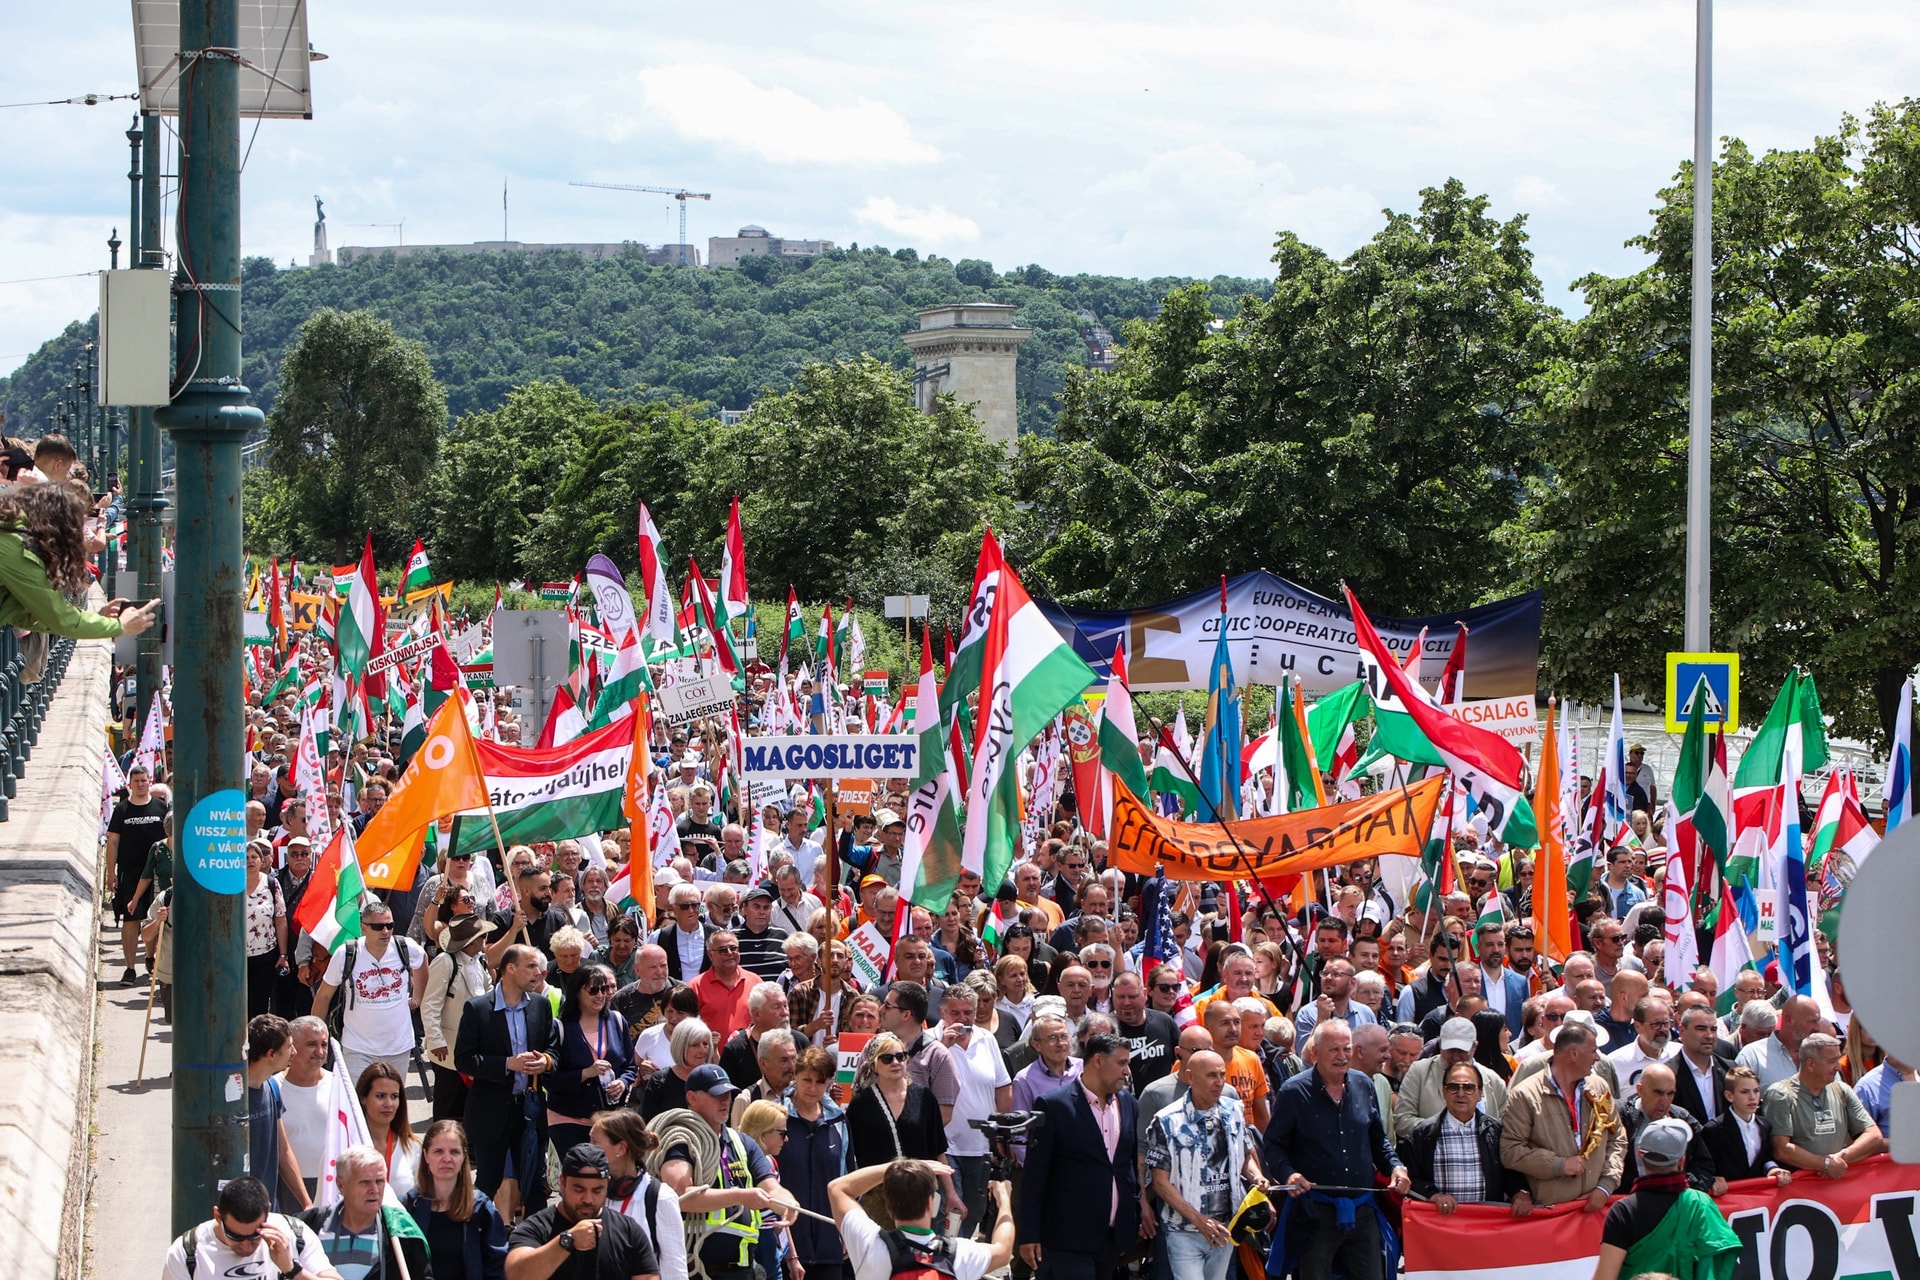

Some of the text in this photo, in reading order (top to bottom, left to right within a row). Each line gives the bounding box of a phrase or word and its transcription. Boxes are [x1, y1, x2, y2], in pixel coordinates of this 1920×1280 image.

[1253, 590, 1340, 619] EUROPEAN
[1202, 616, 1251, 632] CIVIC
[1379, 636, 1451, 652] COUCIL
[368, 634, 440, 673] KISKUNMAJSA
[684, 686, 708, 700] CÖF
[669, 699, 736, 726] ZALAEGERSZEG
[744, 743, 916, 772] MAGOSLIGET
[837, 790, 871, 804] FIDESZ
[208, 842, 215, 852] A
[198, 858, 207, 868] A
[1130, 1036, 1147, 1049] UST
